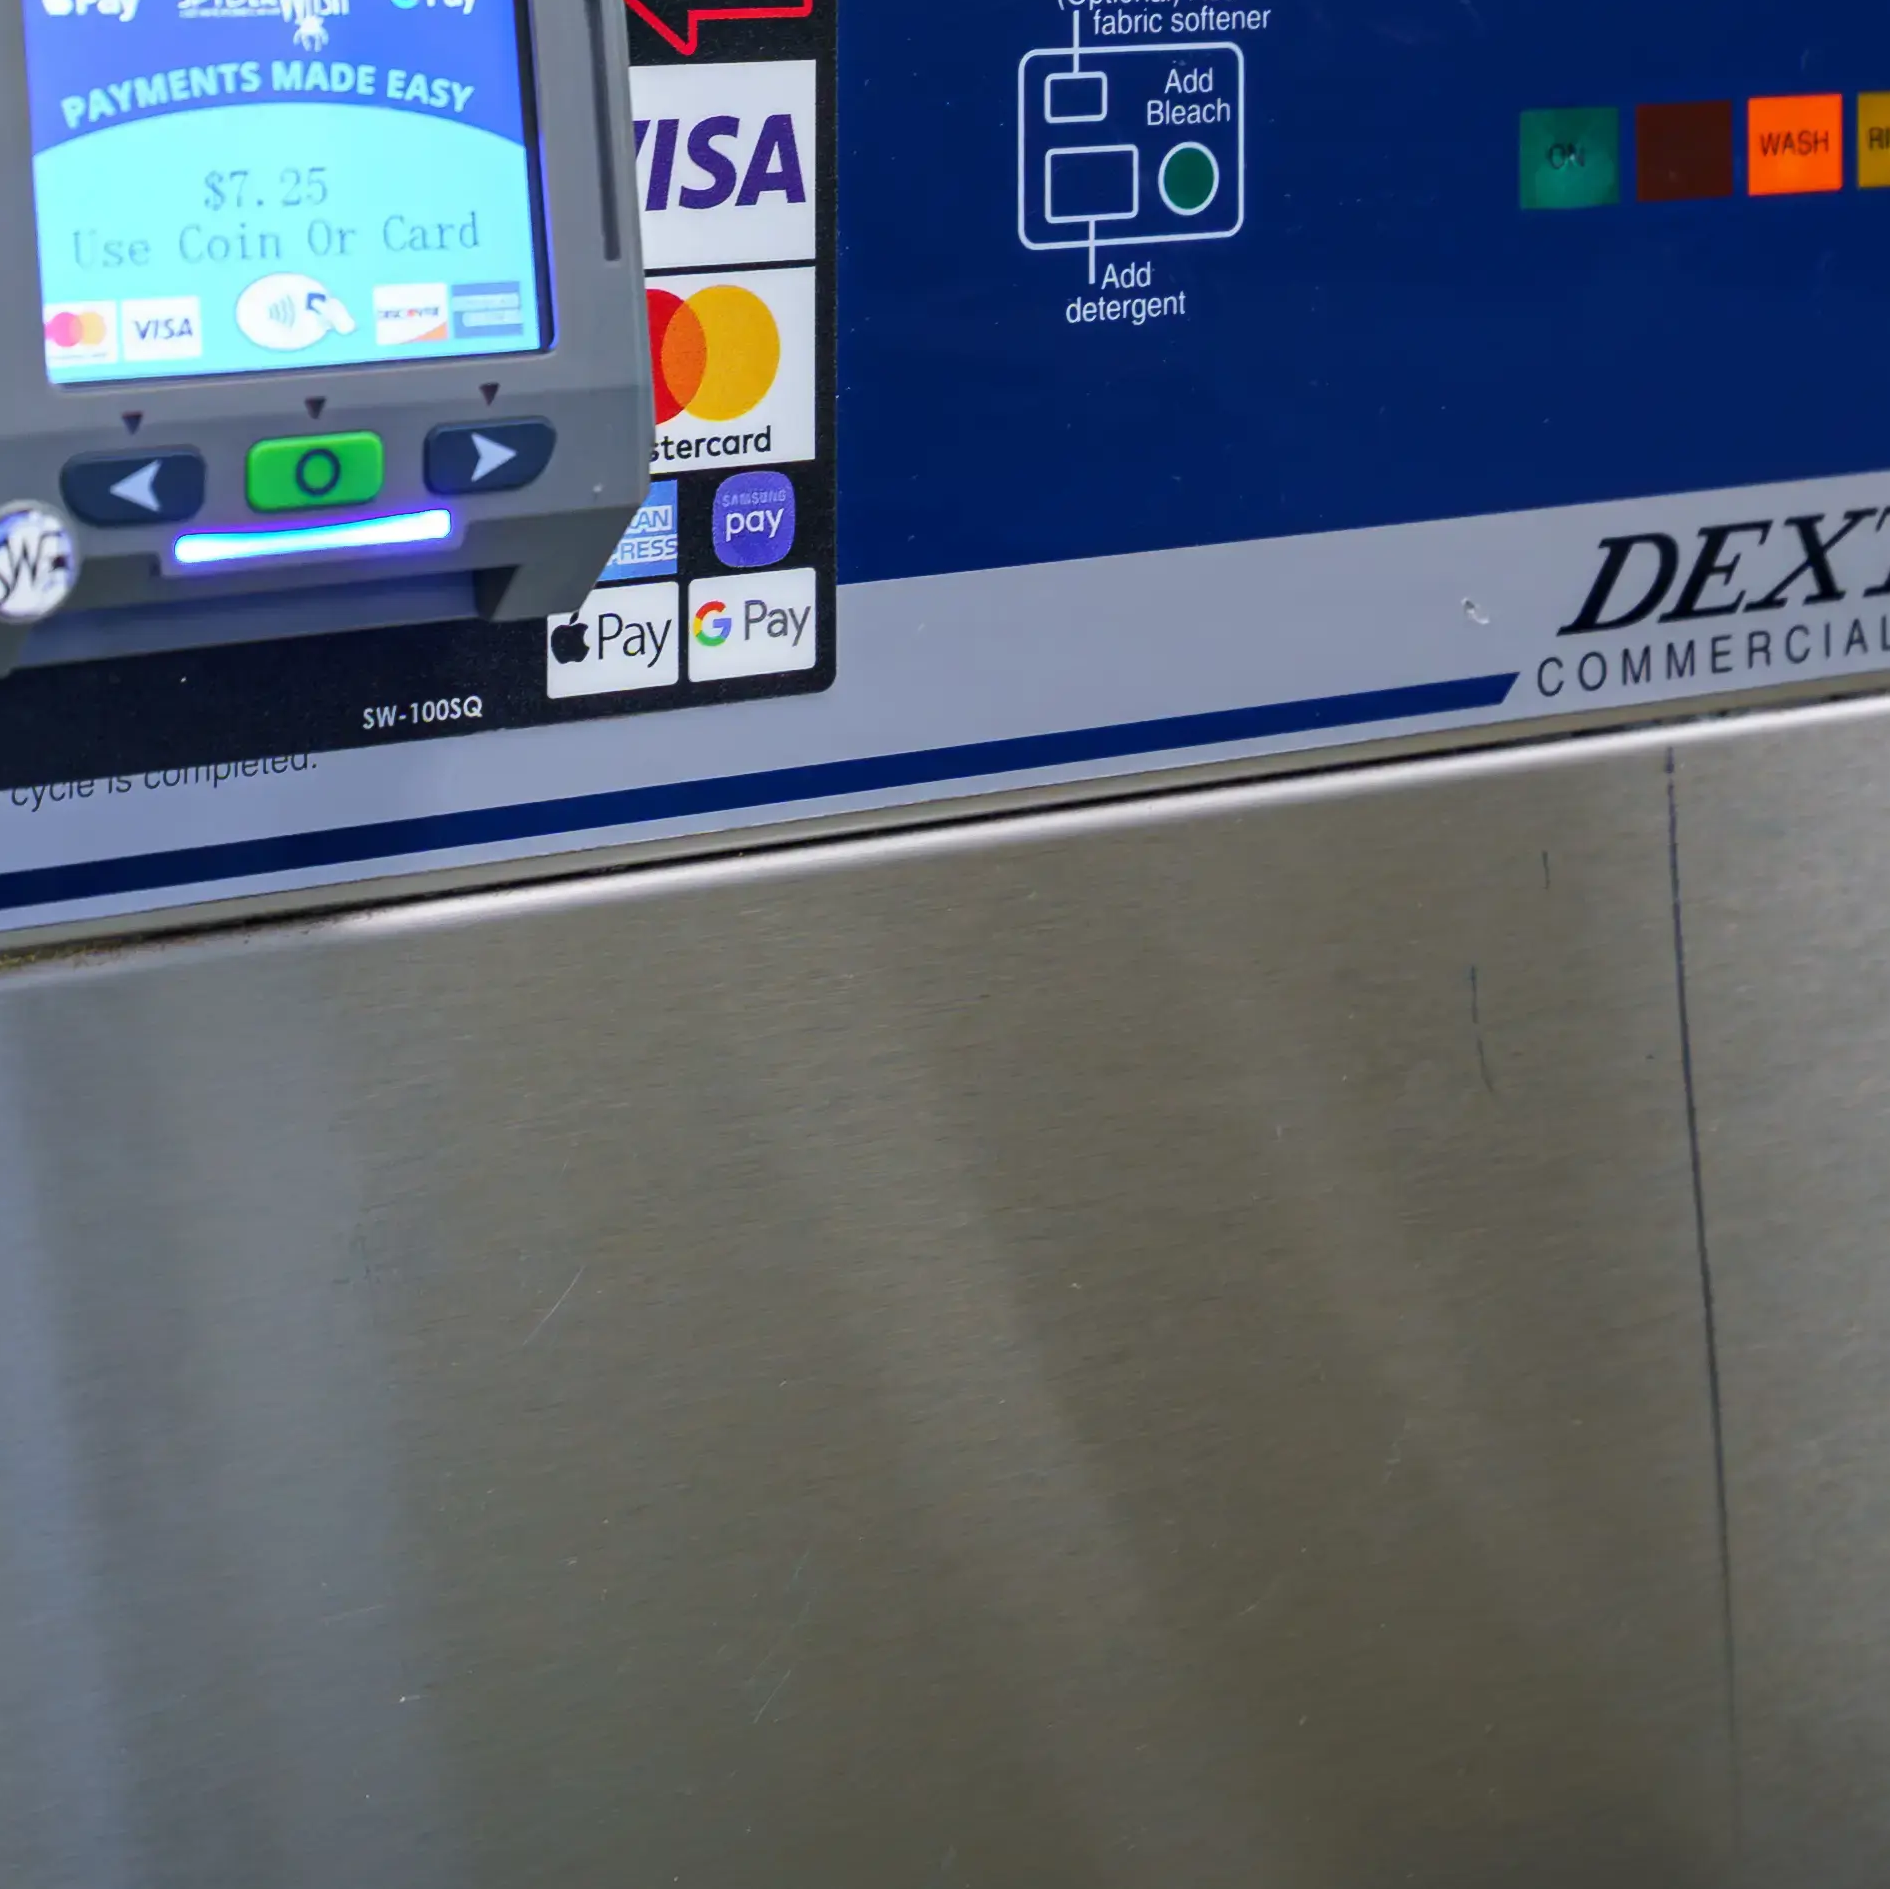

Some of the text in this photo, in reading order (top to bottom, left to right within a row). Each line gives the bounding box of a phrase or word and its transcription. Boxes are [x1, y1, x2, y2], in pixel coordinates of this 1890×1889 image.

[1093, 5, 1271, 35] fabric softener
[61, 61, 474, 129] PAYMENTS MADE EASY
[1164, 68, 1213, 93] Add
[1146, 98, 1231, 126] Bleach
[1546, 143, 1586, 170] ON
[1760, 130, 1829, 157] WASH
[204, 167, 330, 212] $7.25
[71, 212, 481, 269] Use Coin Or Card
[1101, 261, 1152, 290] Add
[1065, 290, 1187, 325] detergent
[134, 317, 193, 340] VISA
[650, 425, 771, 463] stercard
[722, 488, 786, 508] SAMSUNG
[725, 508, 785, 542] pay
[743, 599, 811, 647] Pay
[598, 613, 672, 668] Pay
[362, 695, 483, 730] SW-100SQ
